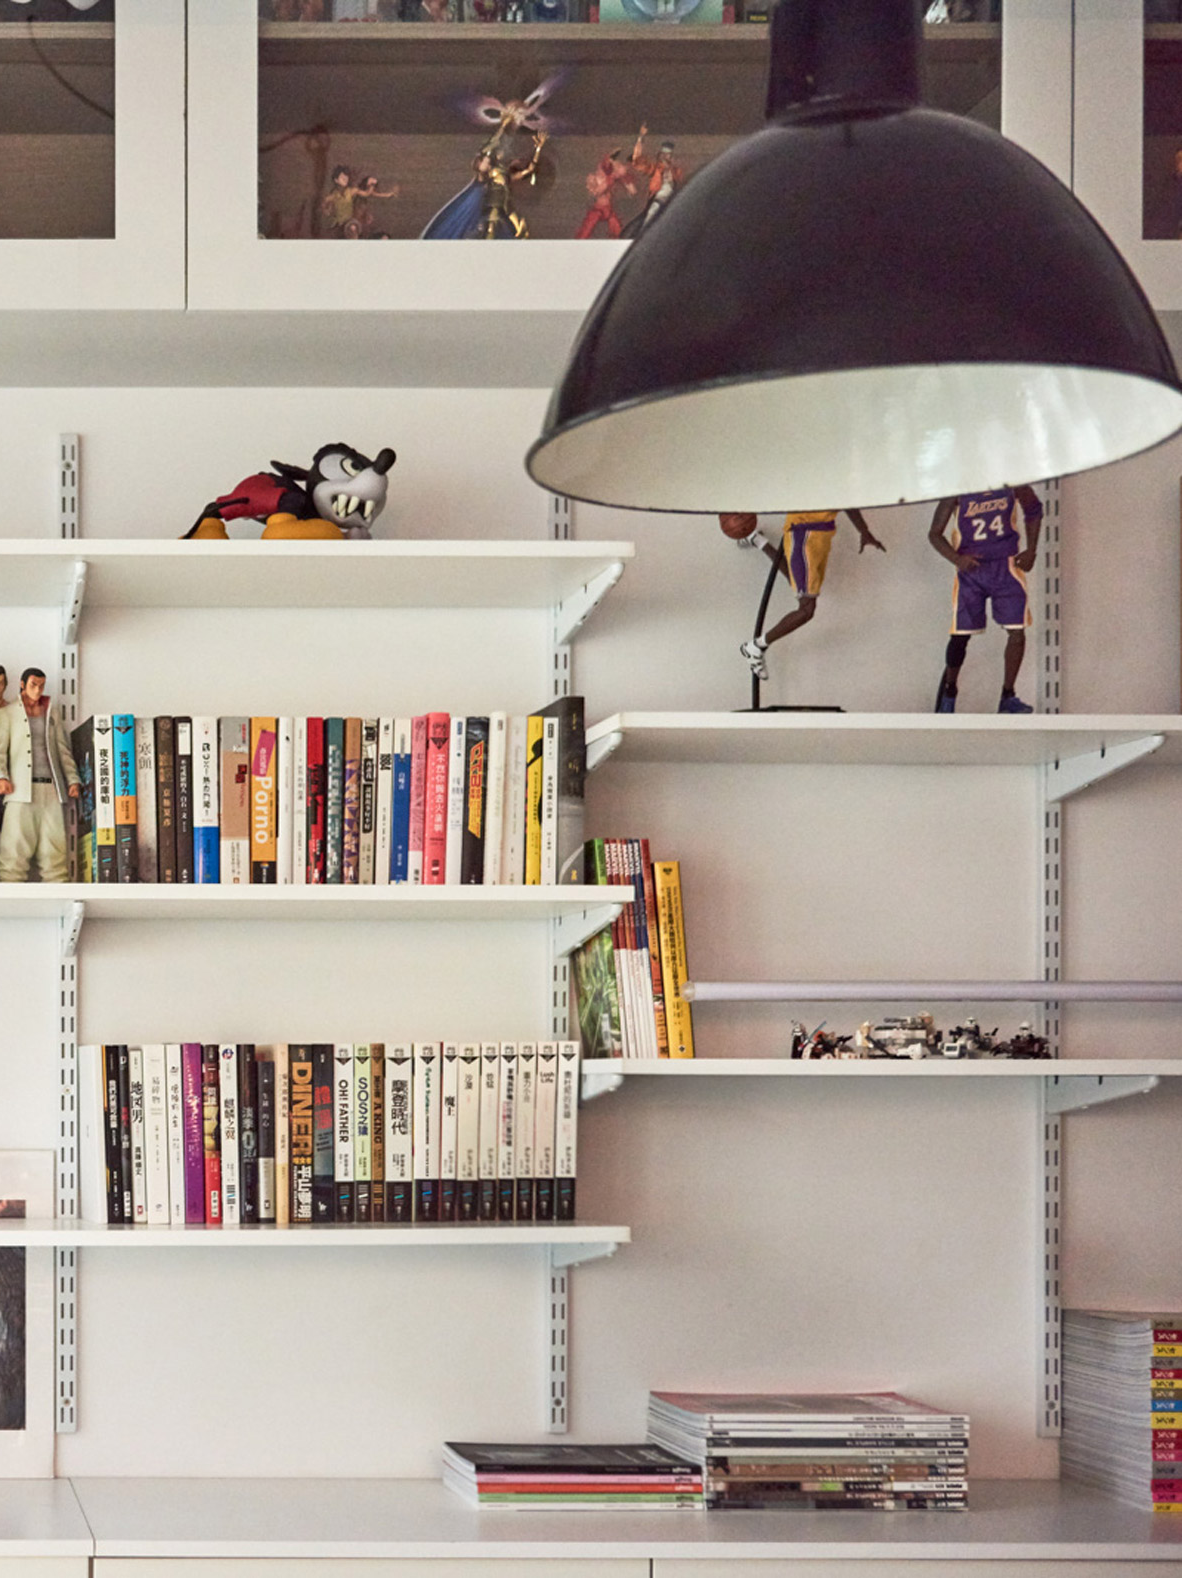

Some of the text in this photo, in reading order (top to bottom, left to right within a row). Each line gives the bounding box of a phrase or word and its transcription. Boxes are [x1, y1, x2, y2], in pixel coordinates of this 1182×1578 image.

[964, 497, 1009, 517] LAKERS
[972, 515, 1005, 540] 24
[120, 751, 130, 796] 死神的浮力
[255, 775, 272, 844] Porno
[224, 1098, 236, 1140] 麒麟之翼
[292, 1062, 312, 1156] DINER
[338, 1079, 350, 1143] OH! FATHER
[373, 1113, 383, 1144] KING
[391, 1079, 407, 1136] 摩登時代
